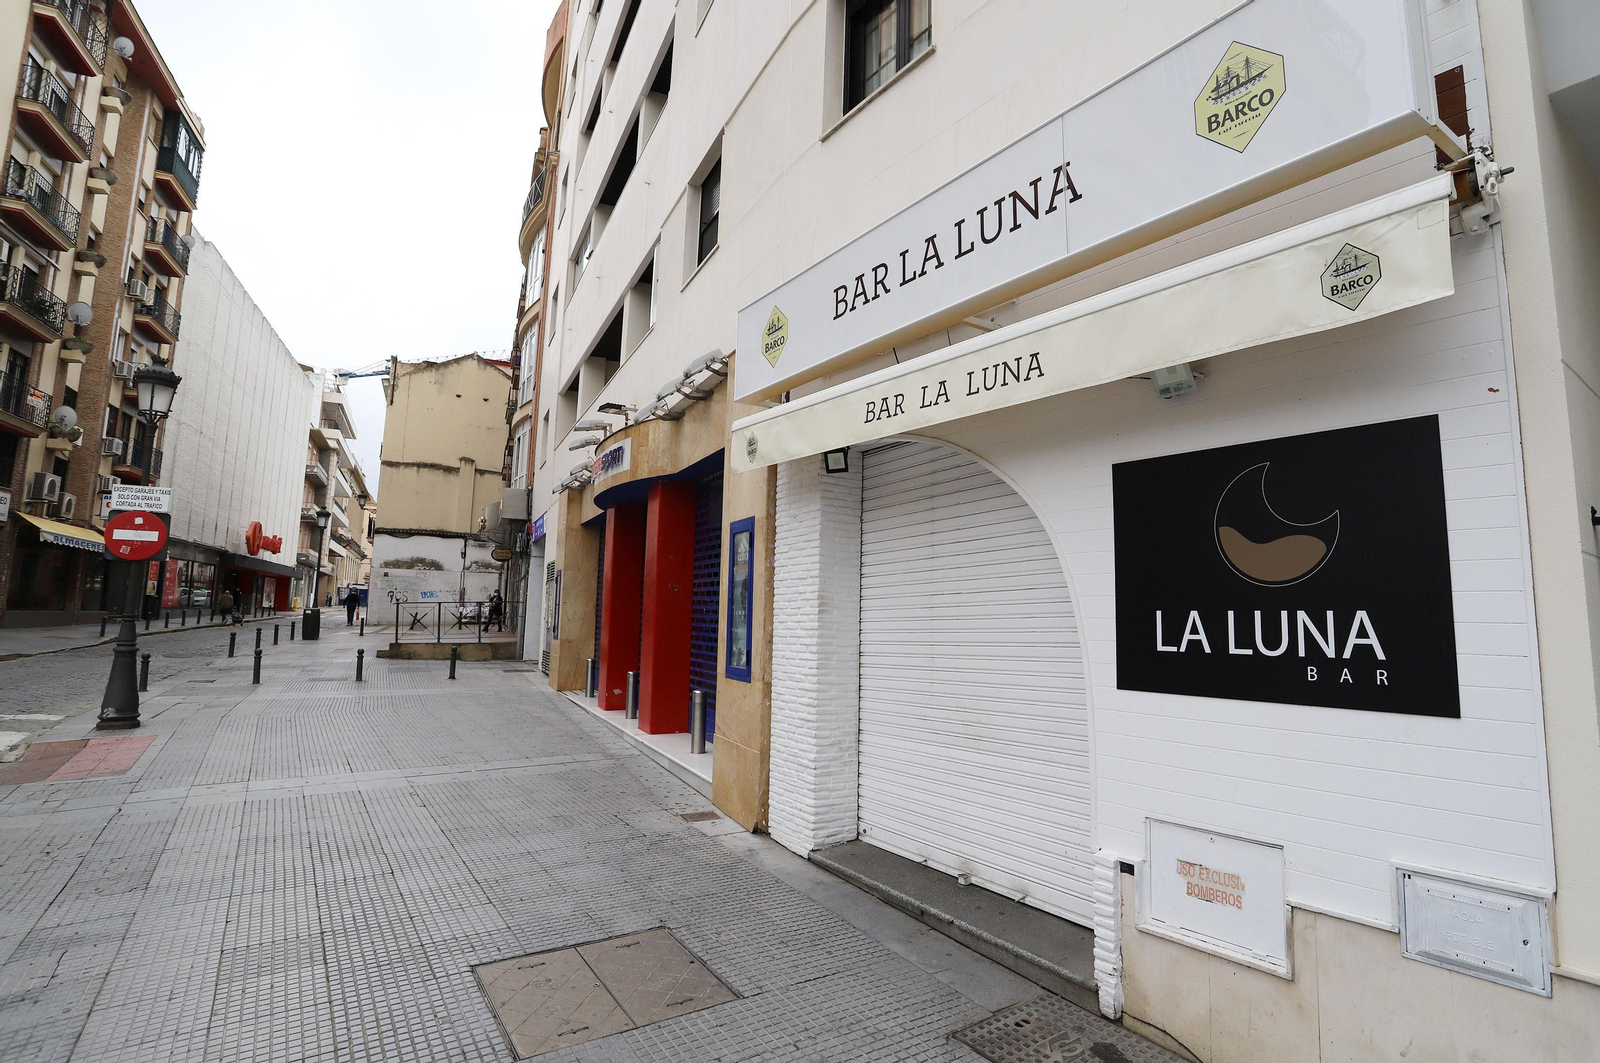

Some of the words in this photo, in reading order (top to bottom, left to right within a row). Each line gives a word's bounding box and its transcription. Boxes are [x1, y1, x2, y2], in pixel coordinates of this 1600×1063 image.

[1207, 88, 1275, 134] BARCO
[832, 262, 891, 321] BAR
[899, 233, 945, 288] LA
[953, 161, 1083, 260] LUNA
[1330, 274, 1374, 296] BARCO
[764, 335, 785, 354] BARCO
[863, 392, 905, 424] BAR
[919, 379, 950, 409] LA
[965, 351, 1045, 396] LUNA
[134, 487, 154, 495] GARAJES
[1155, 610, 1212, 654] LA
[1227, 610, 1387, 661] LUNA
[1307, 666, 1389, 686] BAR
[1176, 860, 1196, 878] USO
[1186, 881, 1243, 910] BOMBEROS
[1452, 909, 1484, 925] AGUA
[1445, 931, 1495, 951] POTABLE
